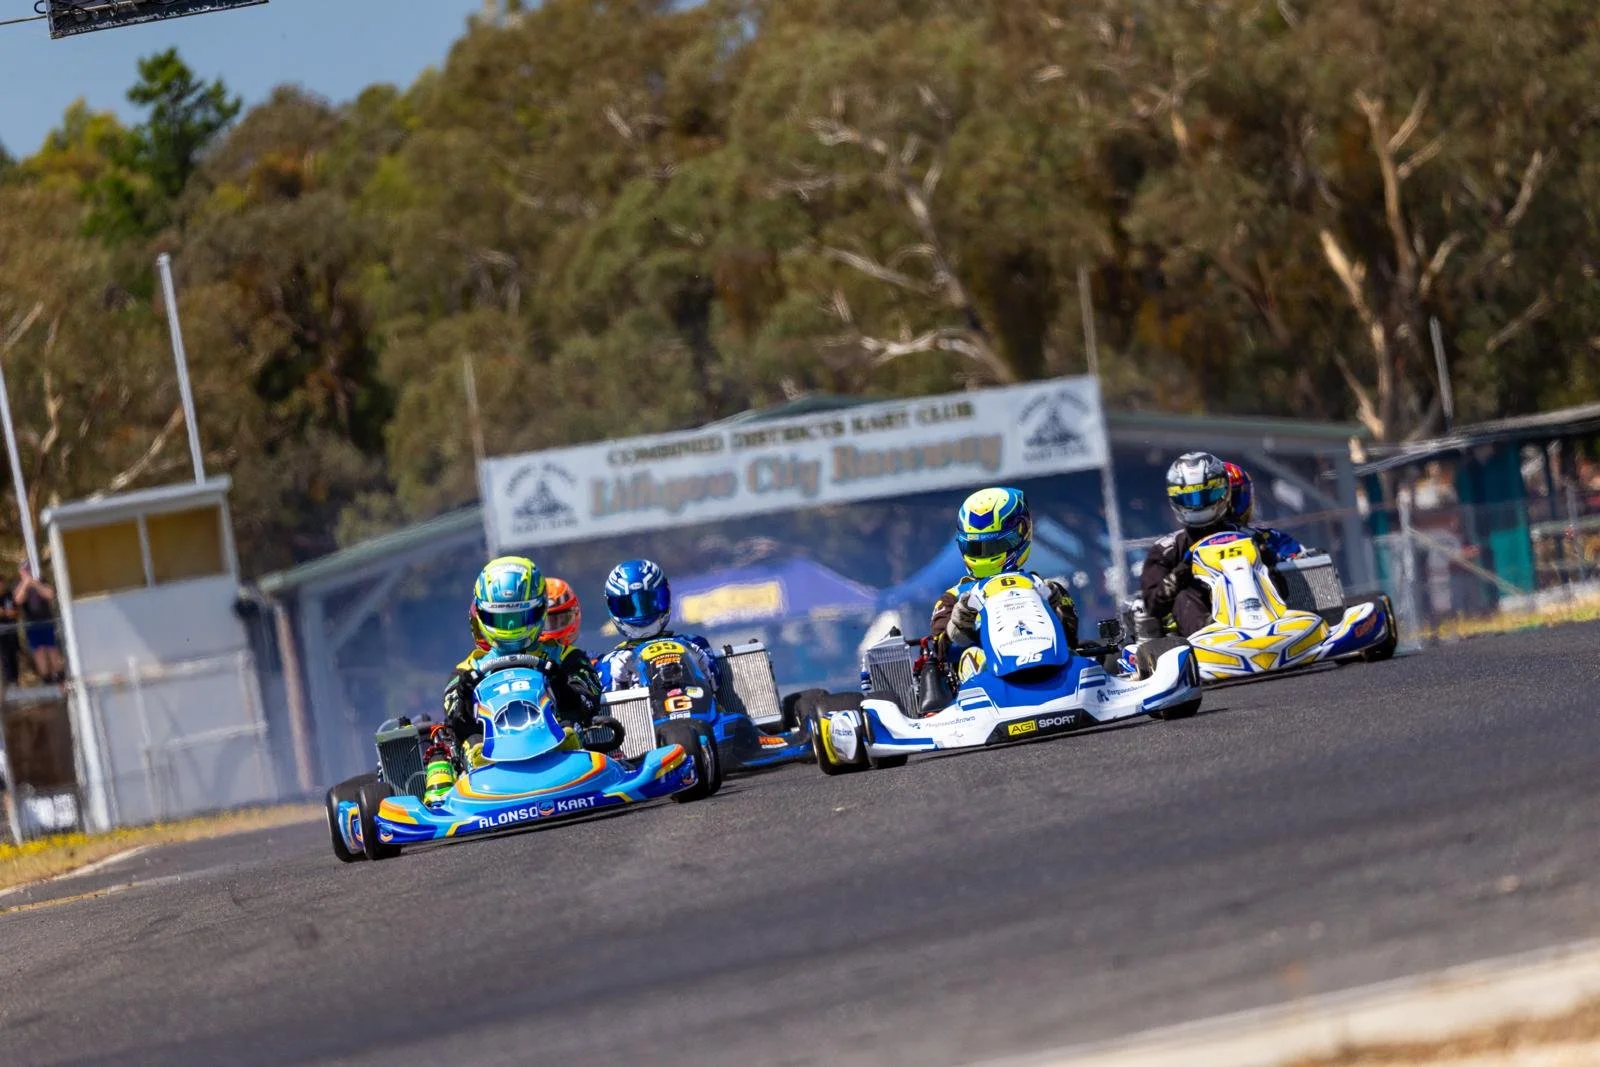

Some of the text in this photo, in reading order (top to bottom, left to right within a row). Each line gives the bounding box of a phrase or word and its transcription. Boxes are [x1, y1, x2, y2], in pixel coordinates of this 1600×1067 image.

[608, 436, 724, 467] COMBINED
[852, 411, 909, 431] KART
[915, 401, 976, 425] CLUB
[745, 452, 822, 498] City
[1215, 546, 1243, 560] 15
[1000, 577, 1017, 587] 6
[1010, 714, 1076, 736] AGI SPORT
[478, 794, 597, 830] ALONSO KART
